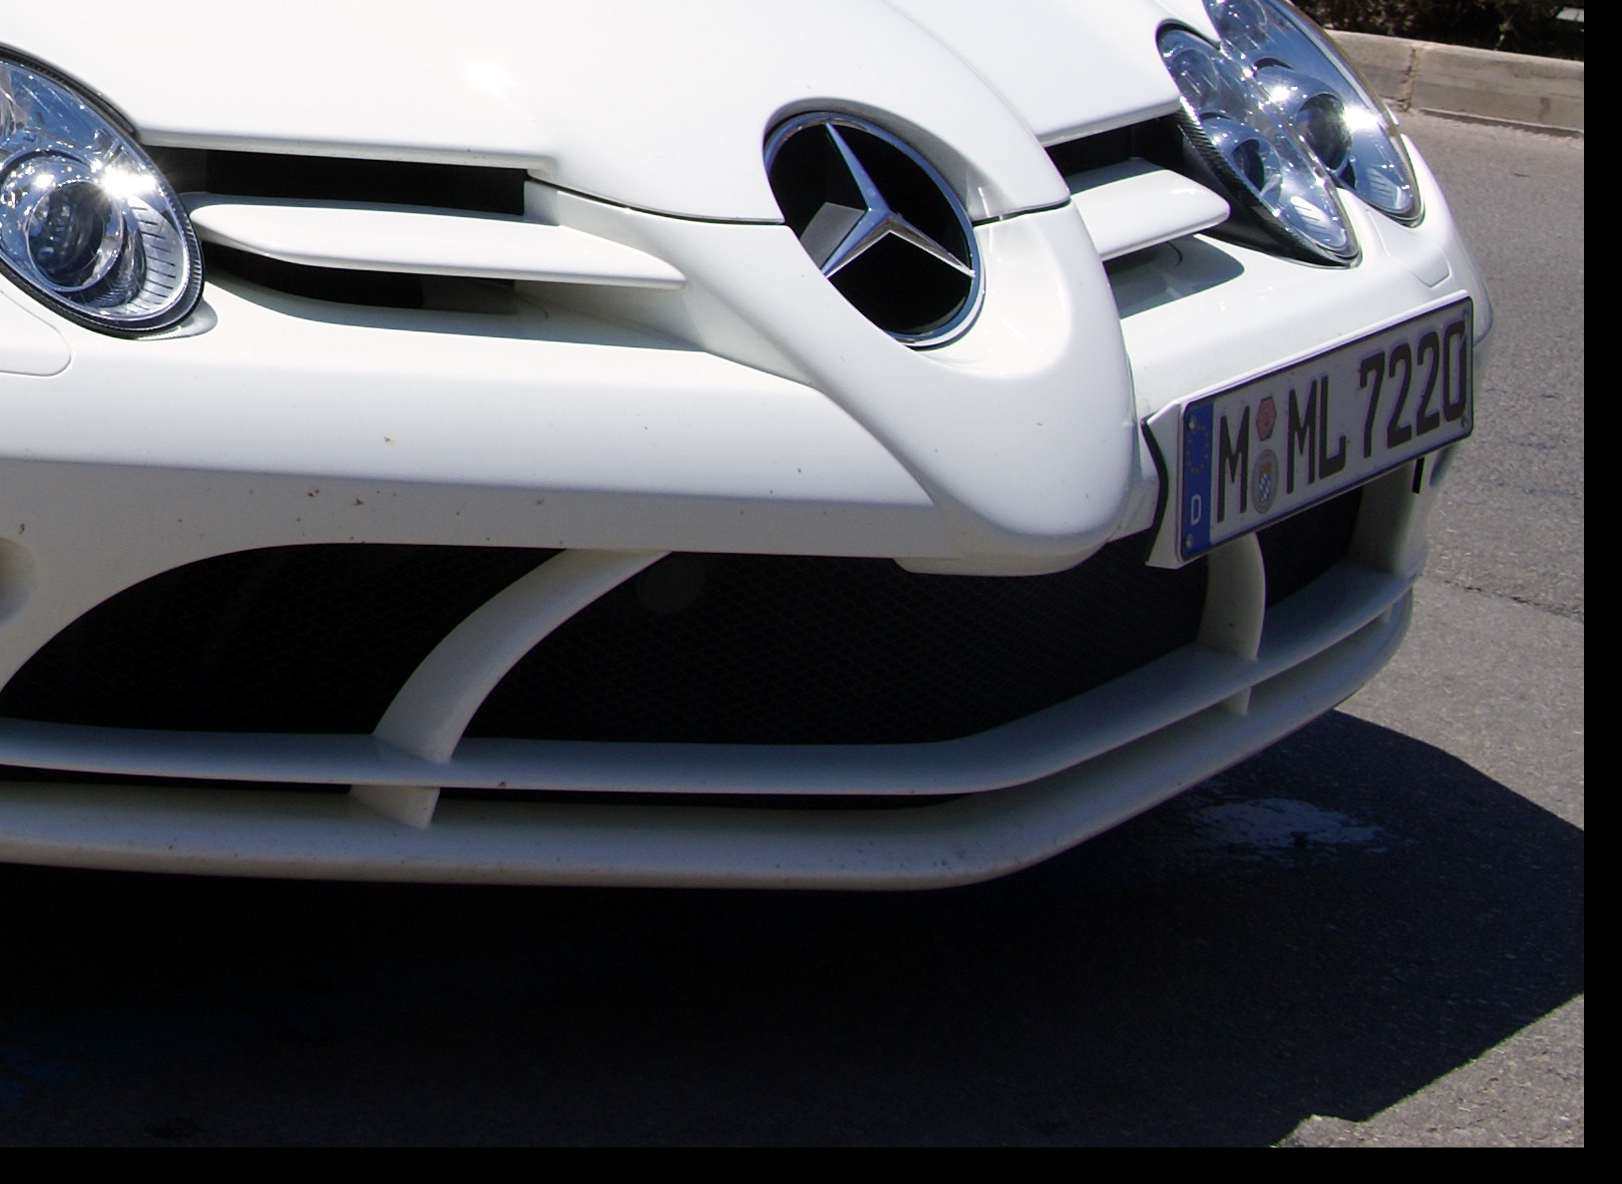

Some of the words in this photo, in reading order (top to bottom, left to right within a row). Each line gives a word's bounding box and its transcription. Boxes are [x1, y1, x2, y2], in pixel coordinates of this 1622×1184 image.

[1217, 406, 1251, 524] M
[1286, 375, 1347, 496] ML
[1360, 318, 1467, 459] 7220
[1190, 494, 1203, 526] D
